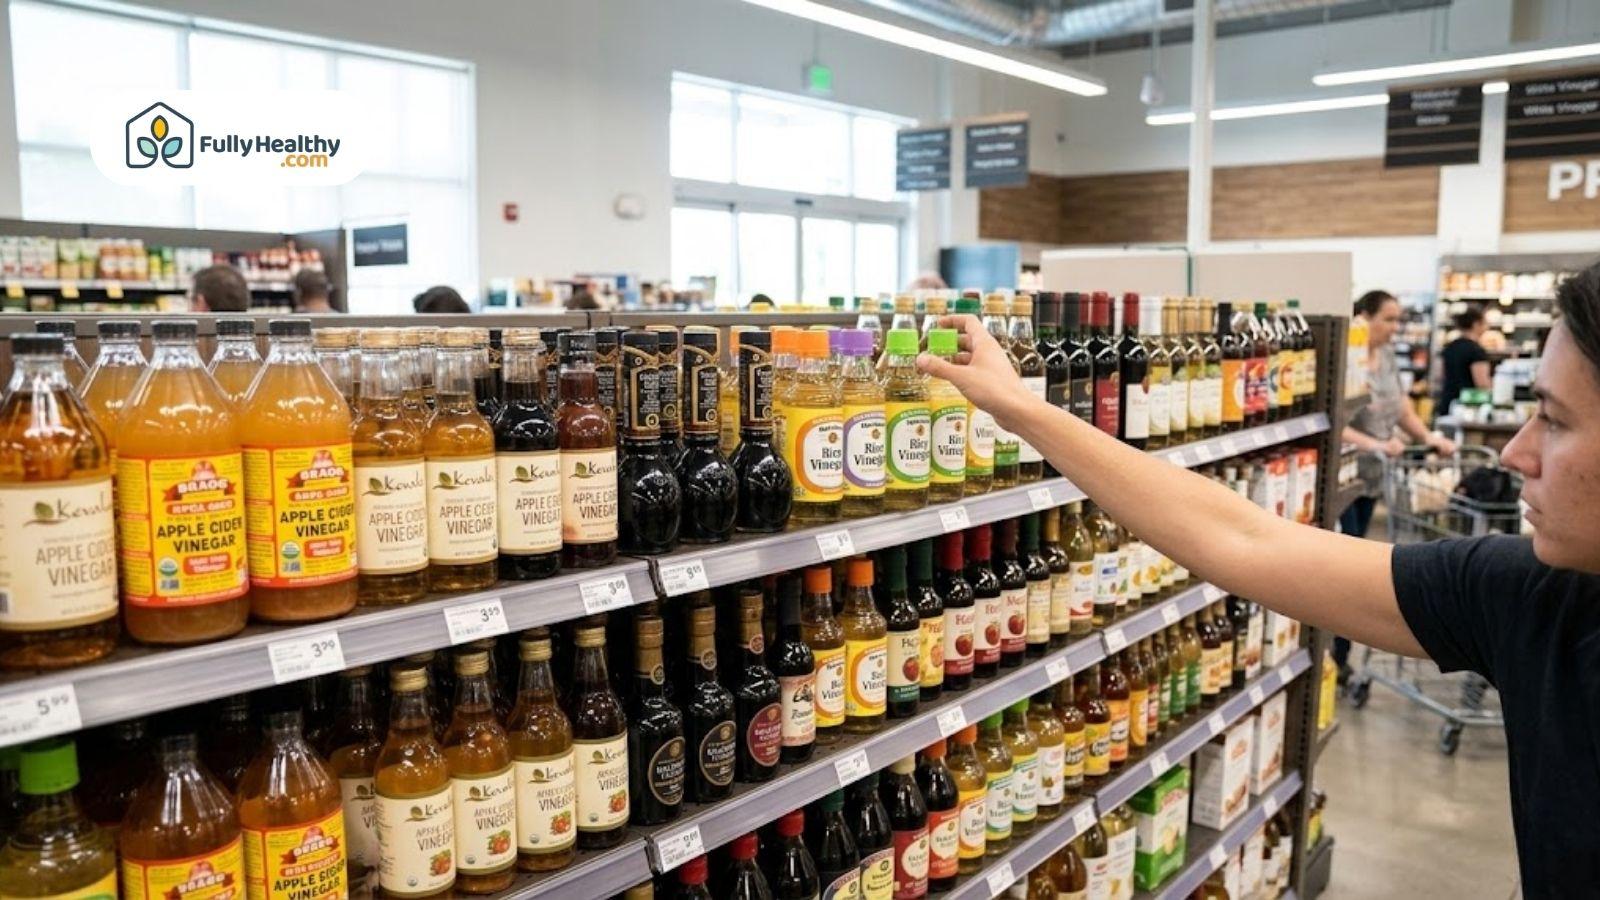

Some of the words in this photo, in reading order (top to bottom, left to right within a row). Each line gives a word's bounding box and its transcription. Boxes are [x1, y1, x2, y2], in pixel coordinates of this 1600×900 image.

[280, 509, 324, 523] APPLE
[157, 523, 205, 538] APPLE
[173, 535, 236, 553] VINEGAR
[35, 543, 83, 565] APPLE
